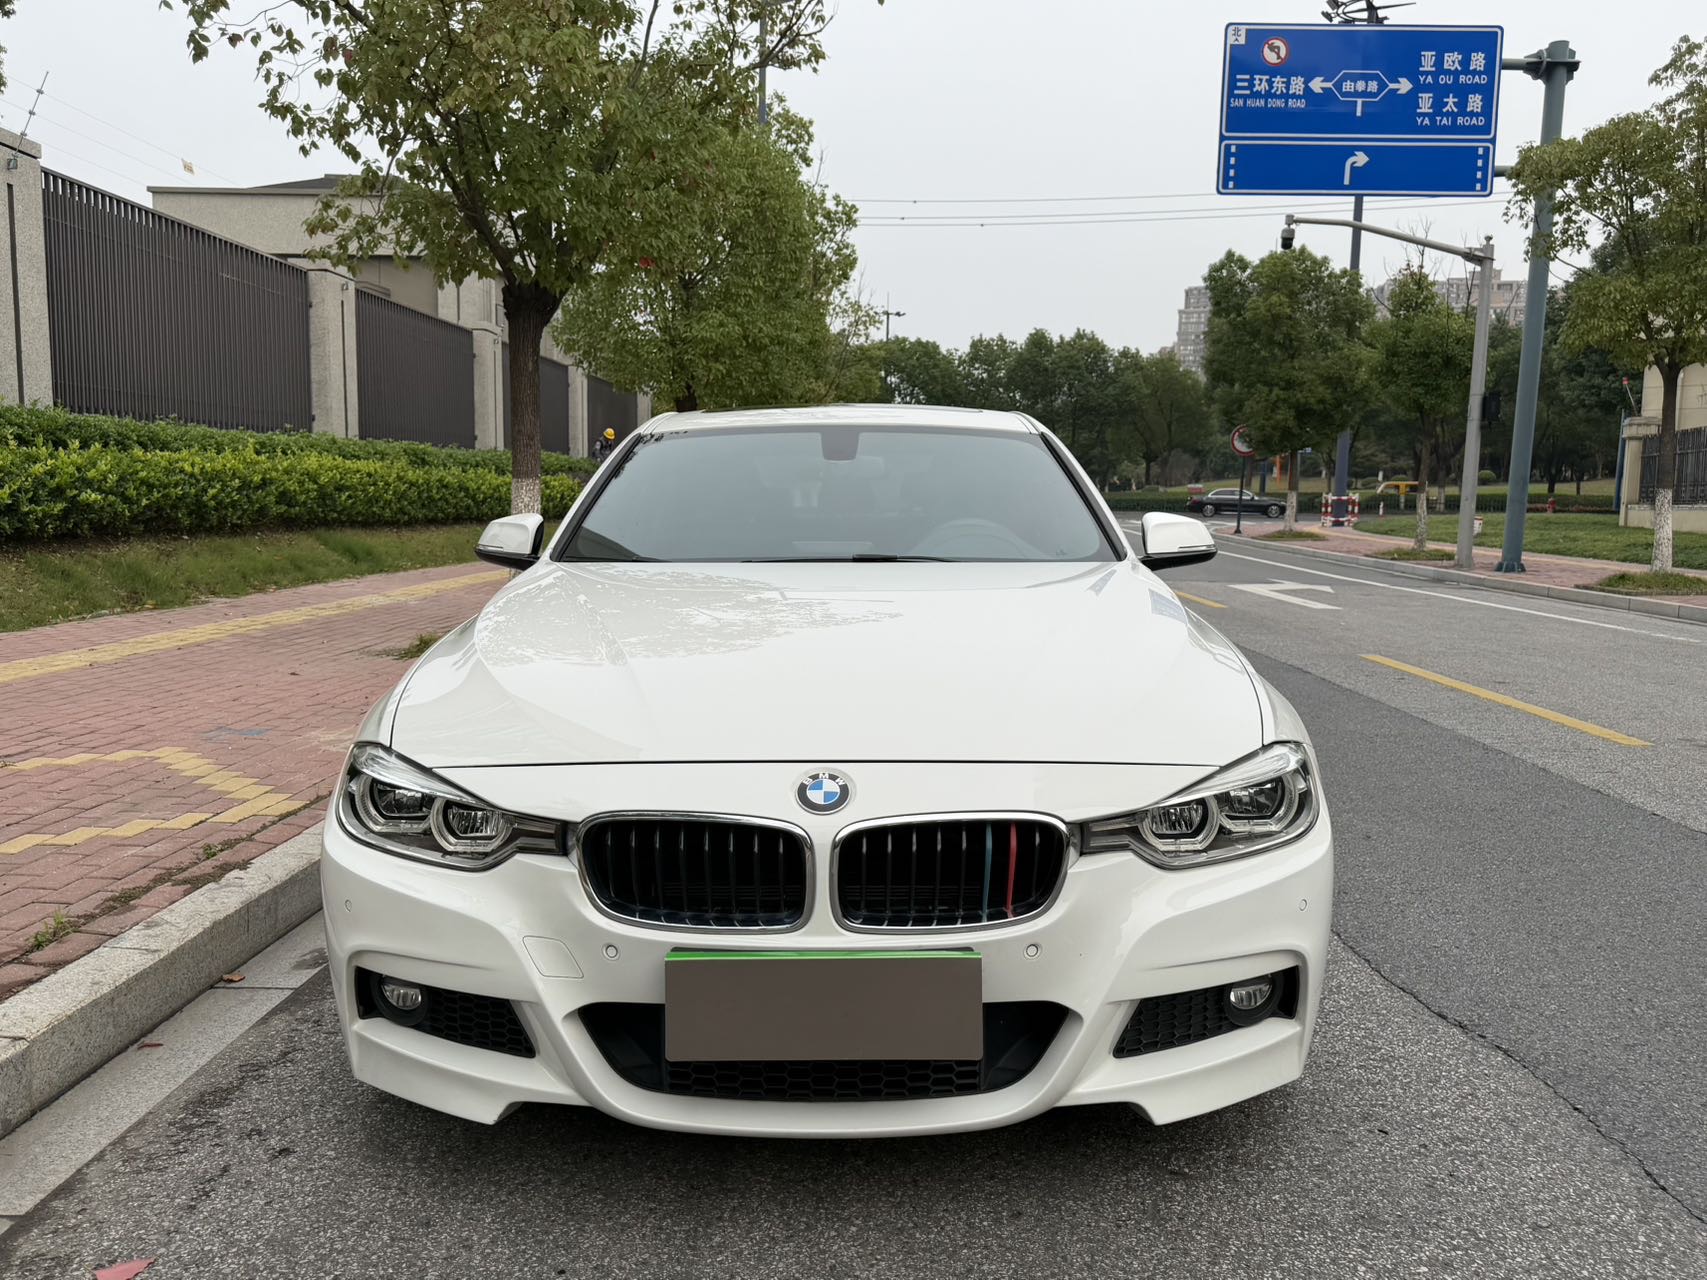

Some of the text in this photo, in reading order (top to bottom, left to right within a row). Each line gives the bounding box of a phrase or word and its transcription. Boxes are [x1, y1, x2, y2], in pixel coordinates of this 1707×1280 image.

[1231, 26, 1242, 37] 北
[1419, 51, 1486, 71] 亚欧路
[1233, 74, 1305, 95] 三环东路
[1418, 75, 1488, 84] YA OU ROAD
[1230, 98, 1306, 108] SAN HUAN DONG ROAD
[1416, 93, 1483, 113] 亚太路
[1416, 116, 1485, 126] YA TAI ROAD
